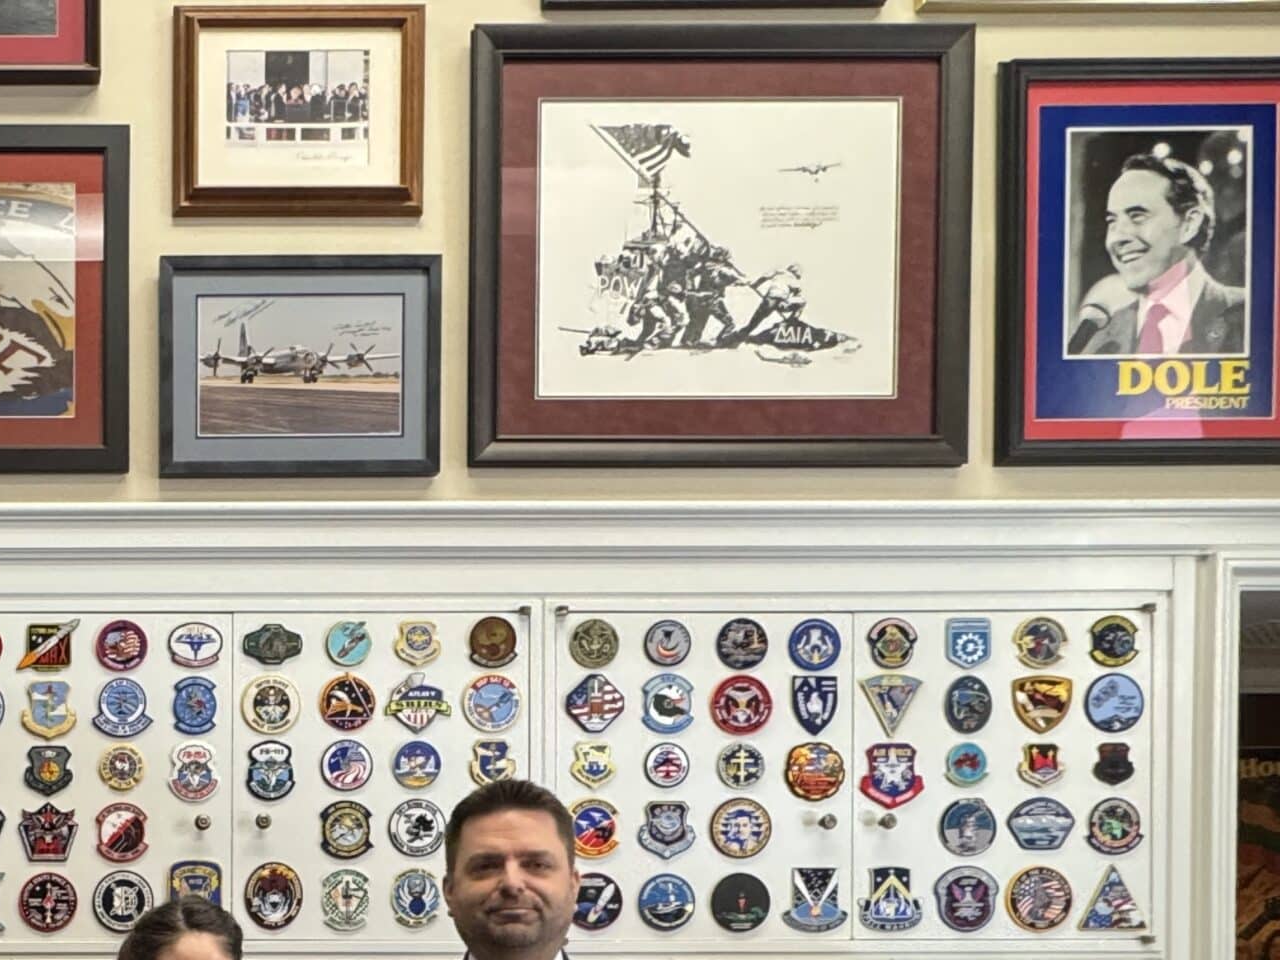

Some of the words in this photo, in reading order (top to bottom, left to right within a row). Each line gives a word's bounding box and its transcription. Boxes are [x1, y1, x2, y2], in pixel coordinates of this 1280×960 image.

[597, 275, 642, 300] POW
[775, 325, 813, 345] MIA
[1116, 360, 1251, 396] DOLE
[1165, 396, 1250, 410] PRESIDENT
